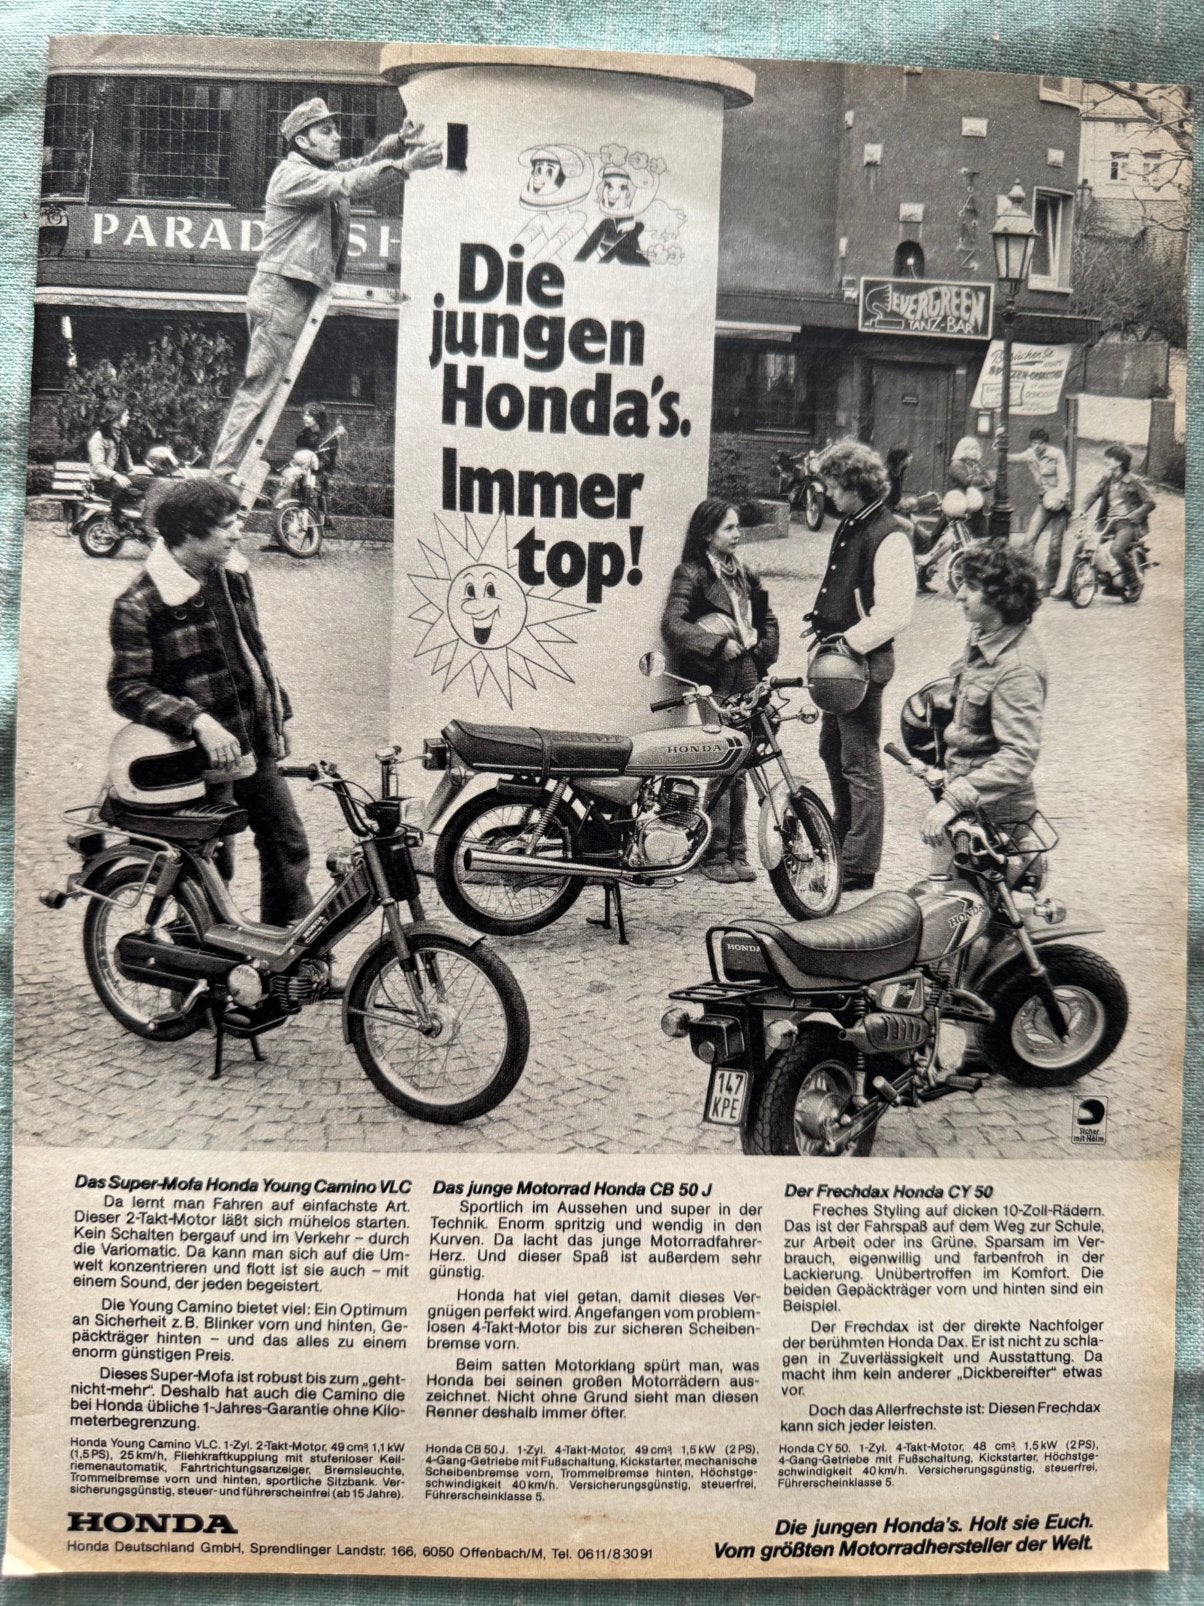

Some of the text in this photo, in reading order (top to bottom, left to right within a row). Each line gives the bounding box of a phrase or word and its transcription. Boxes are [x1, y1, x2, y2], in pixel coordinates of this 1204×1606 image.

[458, 242, 565, 309] Die
[891, 285, 986, 331] EVERGREEN
[428, 292, 645, 373] jungen
[907, 315, 974, 334] TANZ-BAR
[441, 363, 691, 438] Honda's.
[441, 446, 645, 519] Immer
[512, 525, 644, 604] top!
[665, 743, 724, 755] HONDA
[948, 903, 985, 928] HONDA
[718, 1072, 744, 1095] 147
[711, 1096, 740, 1119] KPE
[1079, 1127, 1100, 1135] Sicher
[1086, 1134, 1105, 1143] Helm
[73, 1173, 412, 1196] Das Super-Mofa Honda Young Camino VLC
[432, 1179, 712, 1198] Das junge Motorrad Honda CB 50 J
[783, 1183, 994, 1200] Der Frechdax Honda CY 50
[102, 1194, 410, 1213] Da lernt man Fahren auf einfachste Art.
[459, 1199, 763, 1219] Sportlich im Aussehen und super in der
[812, 1202, 1104, 1220] Freches Styling auf dicken 10-Zoll-Rädern.
[74, 1209, 410, 1230] Dieser 2-Takt-Motor läßt sich mühelos starten.
[429, 1231, 762, 1251] Kurven. Da lacht das junge Motorradfahrer-
[783, 1250, 1105, 1268] brauch, eigenwillig und farbenfroh in der
[456, 1287, 761, 1306] Honda hat viel getan, damit dieses Ver-
[100, 1297, 407, 1321] Die Young Camino bietet viel: Ein Optimum
[810, 1318, 1104, 1334] Der Frechdax ist der direkte Nachfolger
[99, 1366, 148, 1381] Dieses
[149, 1367, 234, 1385] Super-Mofa
[236, 1369, 254, 1384] ist
[256, 1370, 303, 1385] robust
[305, 1371, 327, 1385] bis
[328, 1374, 359, 1385] zum
[455, 1357, 760, 1375] Beim satten Motorklang spürt man, was
[781, 1367, 826, 1382] macht
[831, 1367, 856, 1381] ihm
[862, 1366, 892, 1381] kein
[896, 1366, 952, 1380] anderer
[1062, 1365, 1102, 1378] etwas
[777, 1453, 870, 1468] 4-Gang-Getriebe
[874, 1452, 892, 1464] mit
[1043, 1450, 1099, 1463] Höchstge-
[69, 1461, 167, 1473] riemenautomatik,
[324, 1464, 404, 1477] Bremsleuchte,
[424, 1465, 519, 1478] Scheibenbremse
[525, 1469, 553, 1479] vorn,
[560, 1465, 649, 1479] Trommelbremse
[700, 1466, 758, 1479] Höchstge-
[69, 1471, 160, 1484] Trommelbremse
[164, 1475, 190, 1484] vorn
[195, 1473, 218, 1485] und
[265, 1473, 322, 1488] sportliche
[382, 1477, 405, 1487] Ver-
[67, 1511, 239, 1534] HONDA
[774, 1512, 1094, 1539] Die jungen Honda's. Holt sie Euch.
[66, 1539, 110, 1552] Honda
[113, 1540, 194, 1554] Deutschland
[200, 1541, 244, 1554] GmbH,
[249, 1542, 332, 1557] Sprendlinger
[336, 1543, 386, 1557] Landstr.
[390, 1545, 416, 1558] 166,
[422, 1545, 454, 1558] 6050
[458, 1546, 546, 1560] Offenbach/M,
[550, 1547, 572, 1560] Tel.
[714, 1533, 1093, 1562] Vom größten Motorradhersteller der Welt.
